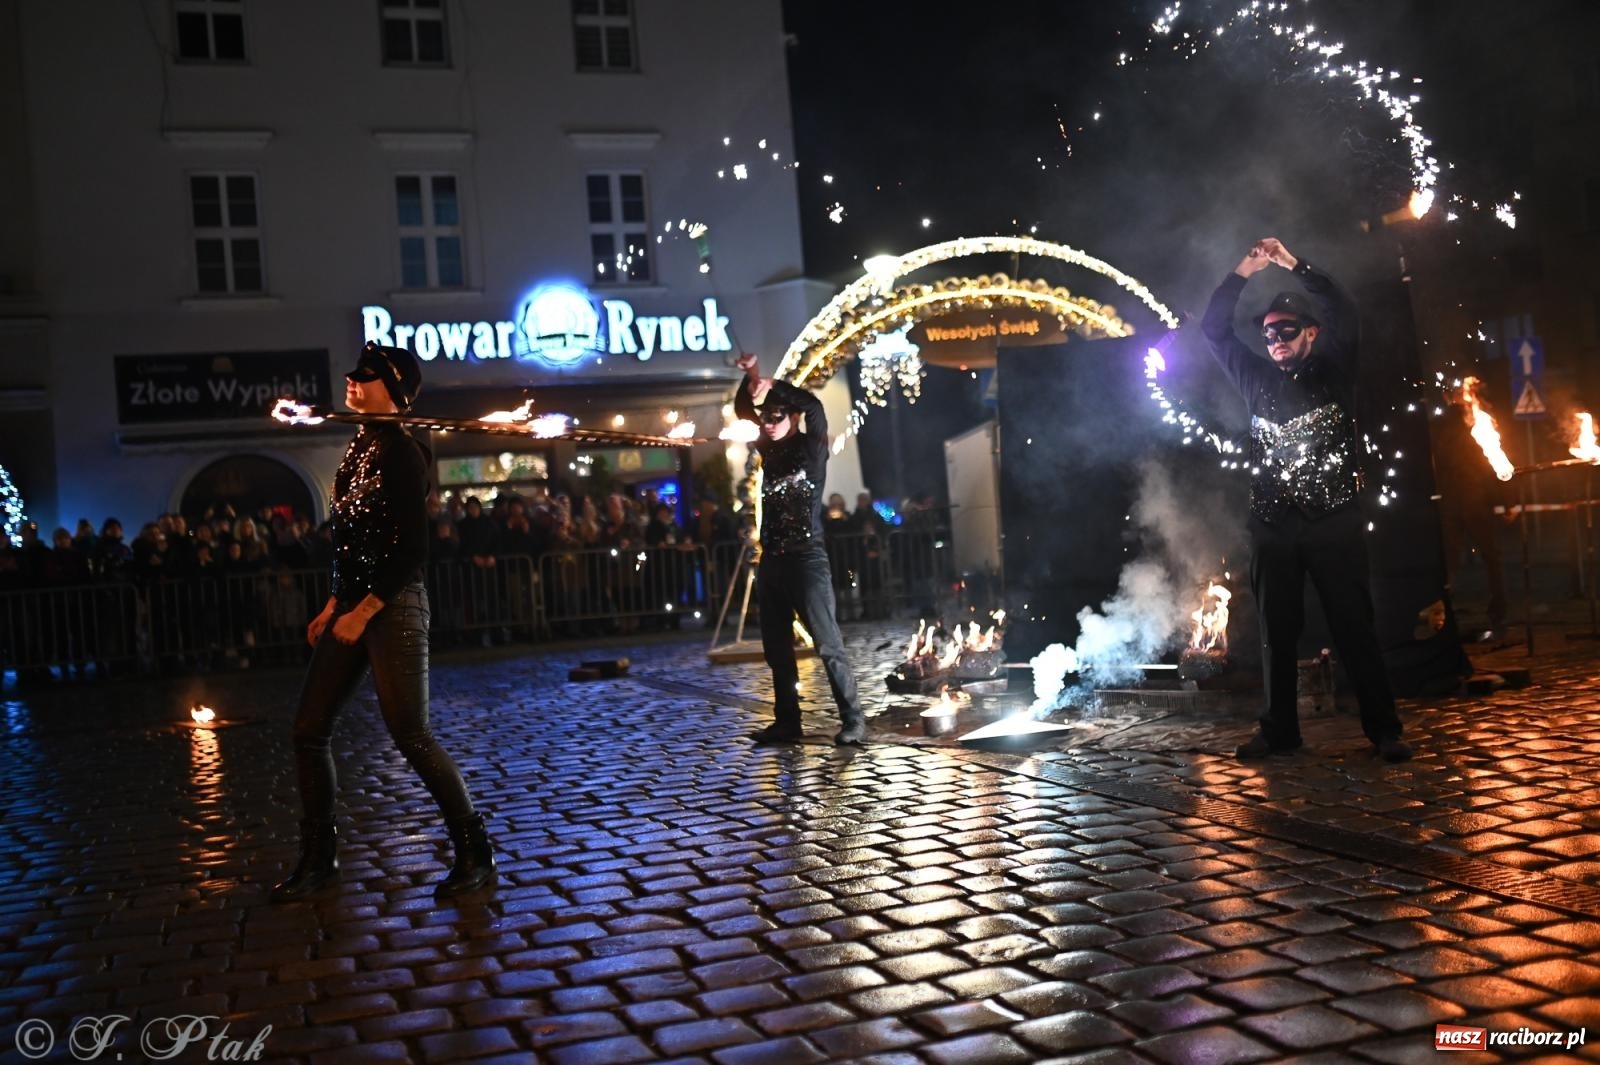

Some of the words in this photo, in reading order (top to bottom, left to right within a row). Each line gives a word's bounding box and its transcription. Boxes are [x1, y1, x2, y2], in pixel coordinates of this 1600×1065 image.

[361, 305, 516, 361] Browar
[605, 298, 732, 361] Rynek
[130, 380, 200, 406] Złote
[206, 373, 318, 406] Wypieki
